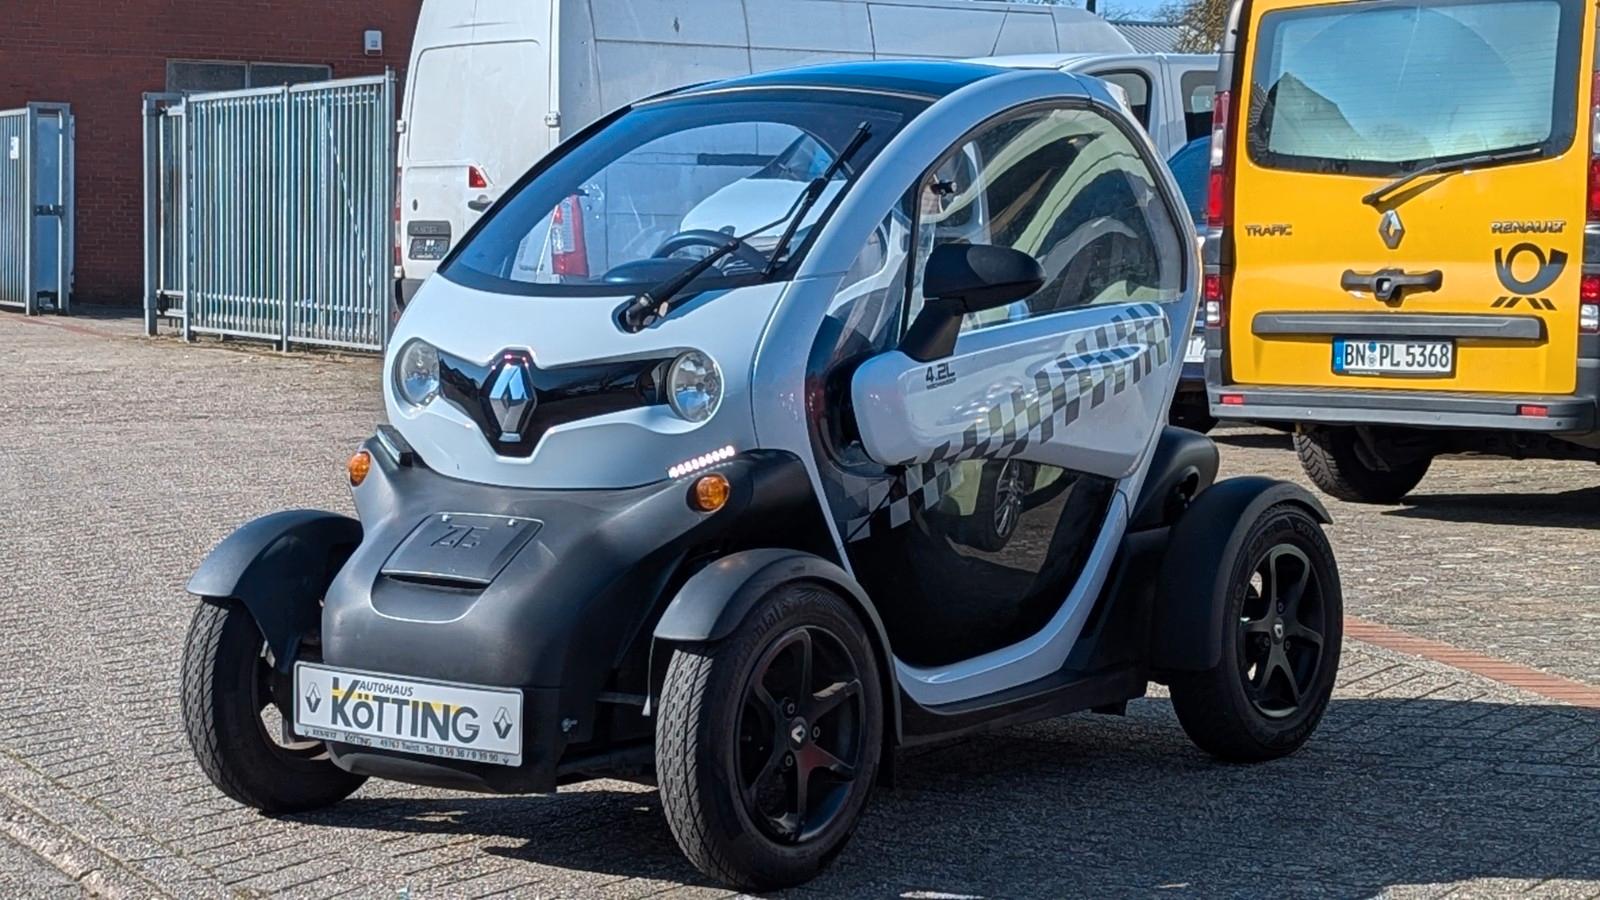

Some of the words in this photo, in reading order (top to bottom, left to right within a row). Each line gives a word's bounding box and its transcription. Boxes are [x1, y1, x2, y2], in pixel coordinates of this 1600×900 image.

[1244, 224, 1292, 237] TRAFIC
[1491, 221, 1567, 234] RENAULT
[1345, 343, 1366, 367] BN
[1379, 344, 1401, 368] PL
[1405, 344, 1450, 369] 5368
[926, 362, 955, 382] 4.2L
[359, 681, 414, 697] AUTOHAUS
[331, 676, 481, 744] KÖTTING
